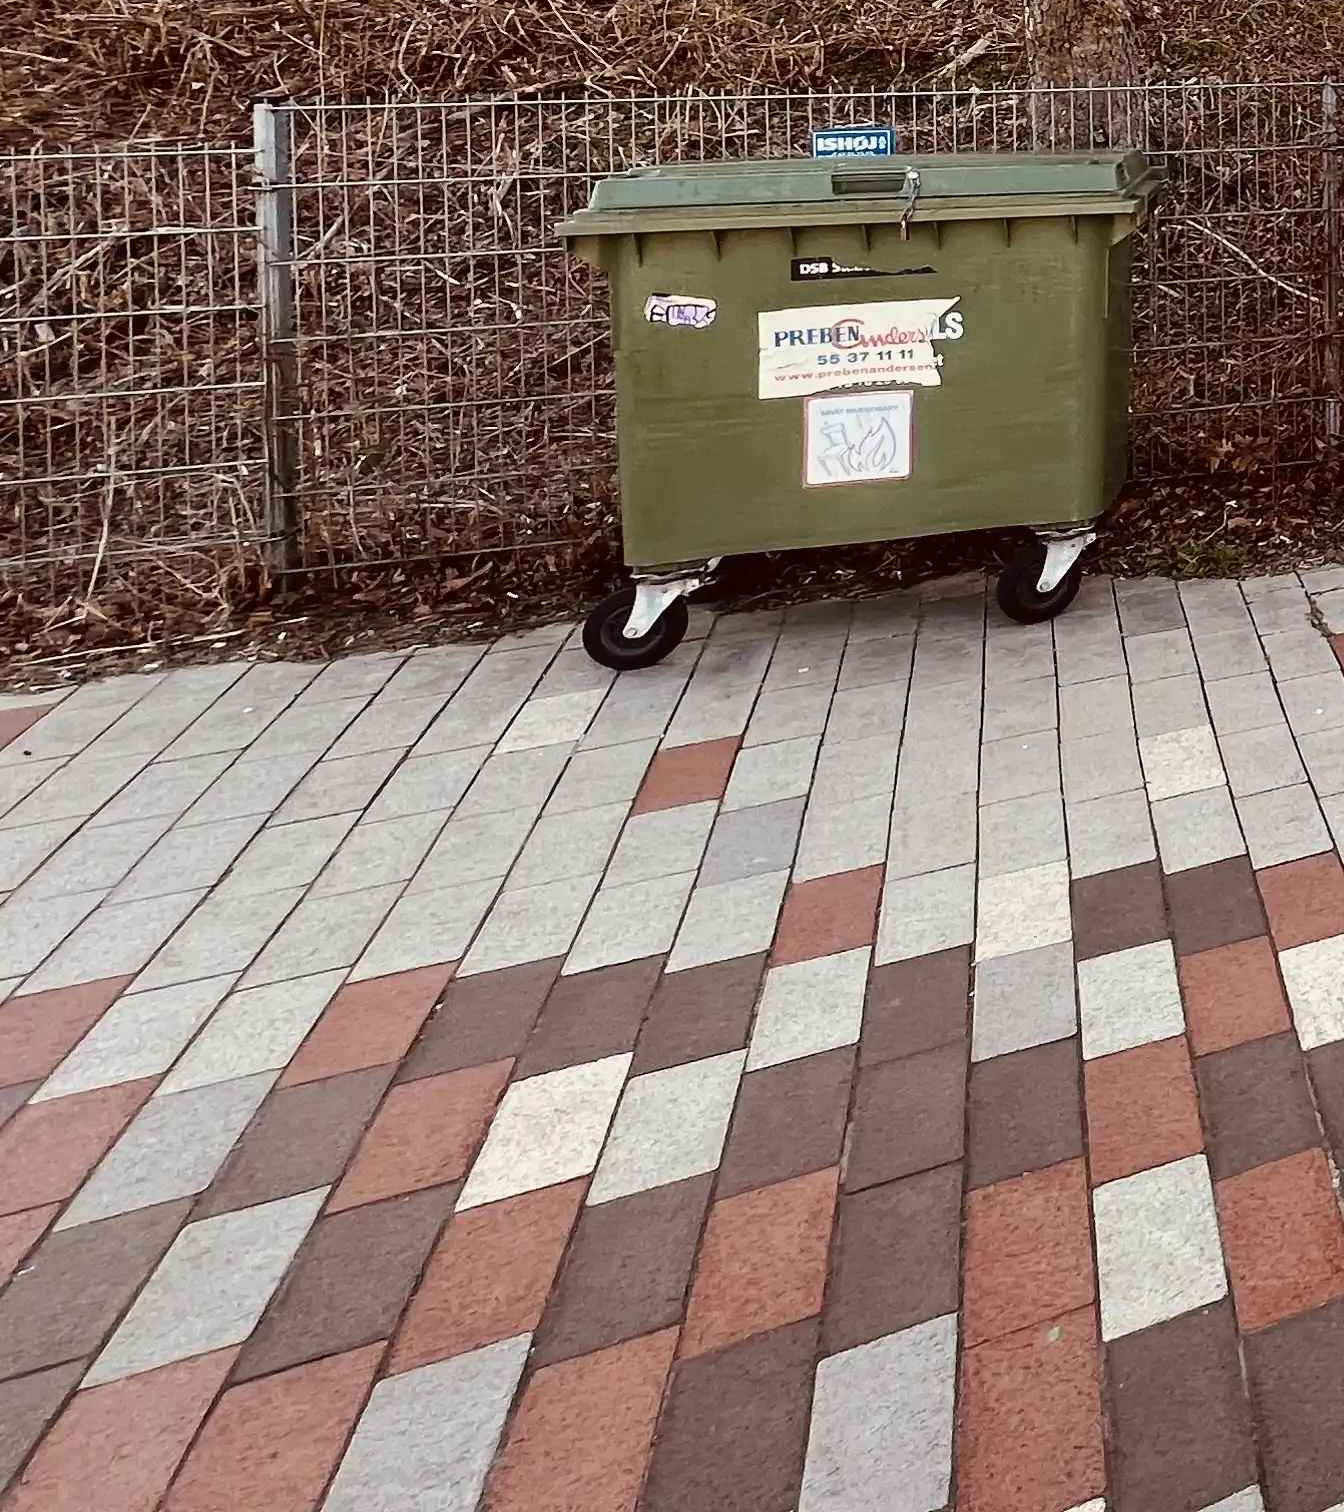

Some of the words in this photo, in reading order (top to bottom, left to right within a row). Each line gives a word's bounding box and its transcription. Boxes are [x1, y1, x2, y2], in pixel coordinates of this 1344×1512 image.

[799, 262, 829, 275] DSB
[773, 325, 860, 348] PREBEN
[816, 354, 841, 366] 55
[846, 351, 870, 364] 37
[876, 350, 893, 362] 11
[897, 348, 915, 360] 11
